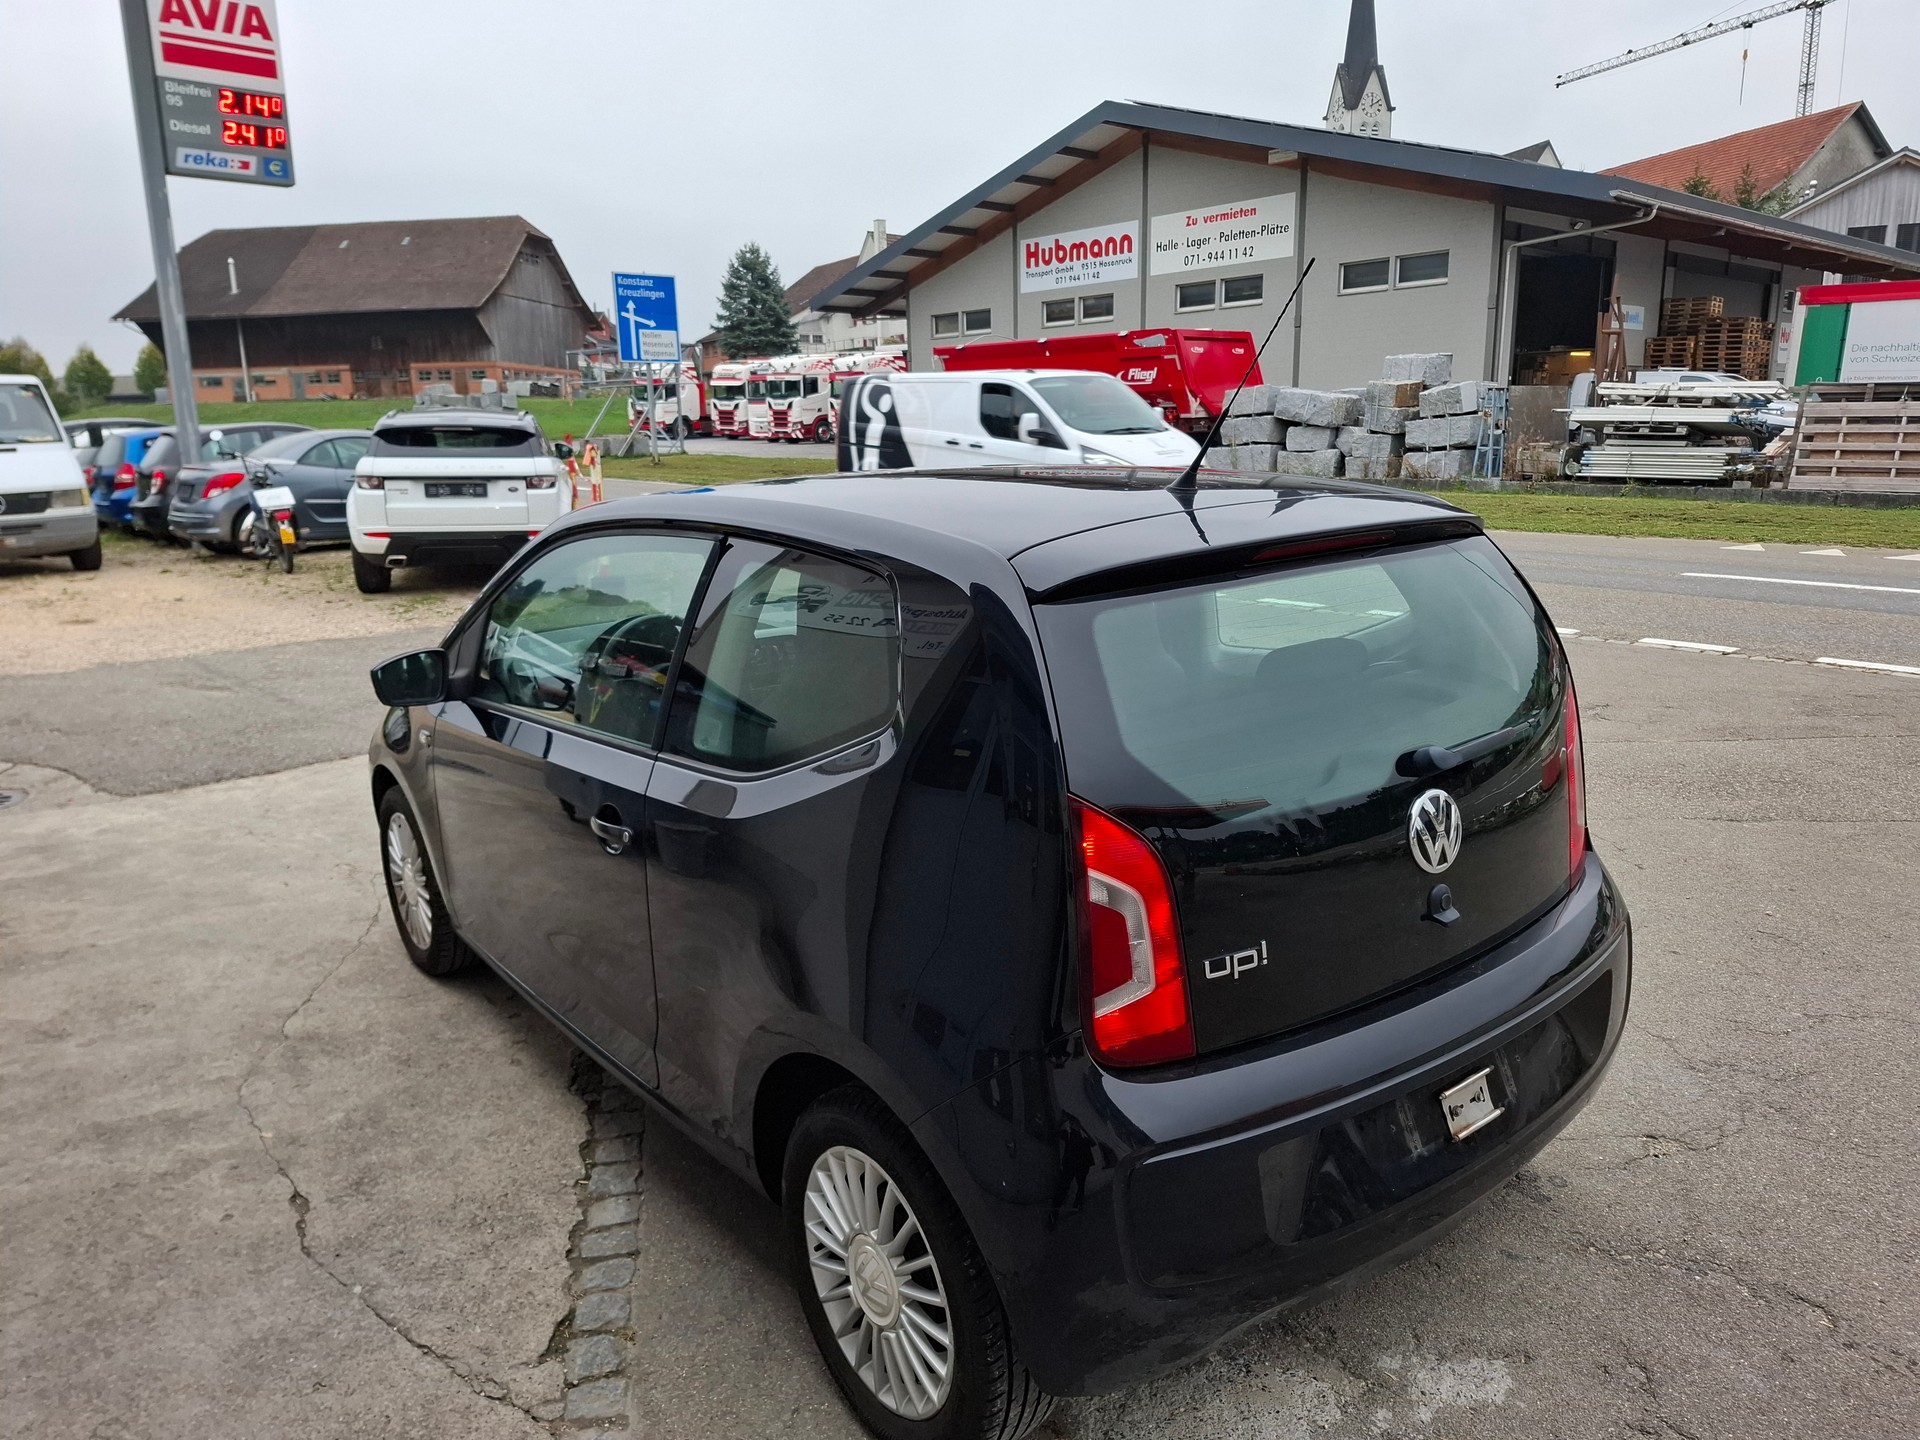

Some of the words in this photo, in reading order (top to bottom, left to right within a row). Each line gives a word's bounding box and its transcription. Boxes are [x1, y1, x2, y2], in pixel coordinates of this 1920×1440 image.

[159, 0, 273, 42] AVIA
[164, 80, 212, 98] Bleifrei
[165, 94, 183, 107] 95
[169, 119, 212, 135] Diesel
[1185, 215, 1198, 227] Zu
[1203, 207, 1257, 224] vermieten
[1156, 239, 1179, 253] Halle
[1186, 236, 1211, 250] Lager
[1219, 223, 1290, 243] Paletten-Plätze
[1025, 233, 1133, 269] Hubmann
[1228, 248, 1239, 260] 11
[1242, 245, 1254, 258] 42
[1025, 269, 1053, 279] Transport
[1055, 265, 1074, 275] GmbH
[1081, 261, 1097, 271] 9515
[1099, 256, 1133, 267] Hosenruck
[617, 276, 653, 286] Konstanz
[1055, 277, 1067, 285] 071
[1069, 274, 1080, 282] 944
[618, 287, 665, 300] Kreuzlingen
[1851, 343, 1868, 353] Die
[1849, 356, 1868, 364] von
[1127, 367, 1158, 382] Fliegl
[1204, 940, 1268, 980] up!
